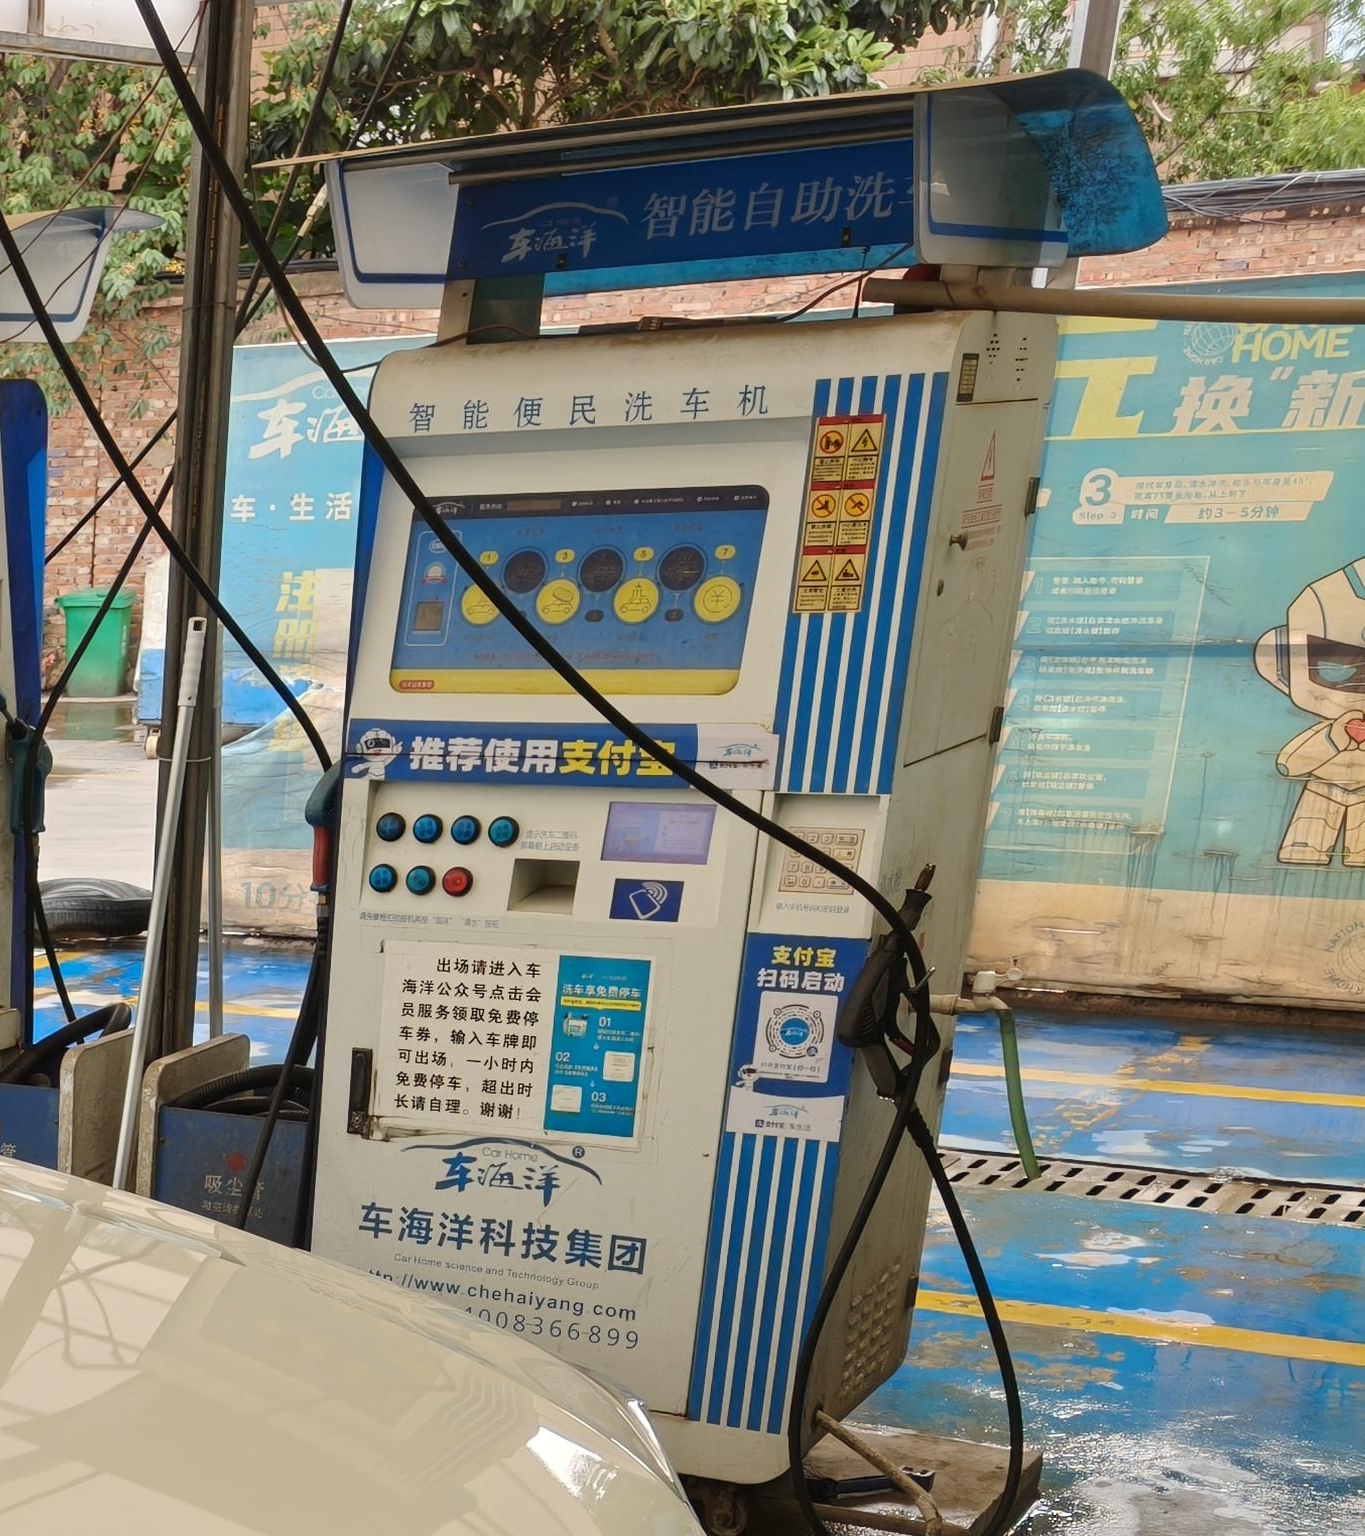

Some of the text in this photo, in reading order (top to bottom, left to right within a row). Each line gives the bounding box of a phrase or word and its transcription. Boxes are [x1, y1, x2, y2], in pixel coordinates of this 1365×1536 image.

[1232, 327, 1355, 364] HOME
[409, 384, 769, 433] 智能便民洗车机
[437, 957, 541, 978] 出场请进入车
[771, 946, 837, 968] 支付宝
[402, 979, 542, 1002] 海洋公众号点击会
[562, 984, 642, 999] 洗车享免费停车
[757, 968, 845, 993] 扫码启动
[401, 1002, 540, 1027] 员服务领取免费停
[598, 1016, 612, 1028] 01
[399, 1026, 537, 1051] 车券，输入车牌即
[398, 1049, 534, 1074] 可出场，一小时内
[555, 1051, 570, 1062] 02
[396, 1071, 533, 1098] 免费停车，超出时
[591, 1091, 607, 1102] 03
[358, 1202, 648, 1275] 车海洋科技集团
[445, 1261, 483, 1273] science
[485, 1266, 504, 1277] and
[507, 1268, 565, 1287] Technology
[567, 1277, 599, 1291] Group
